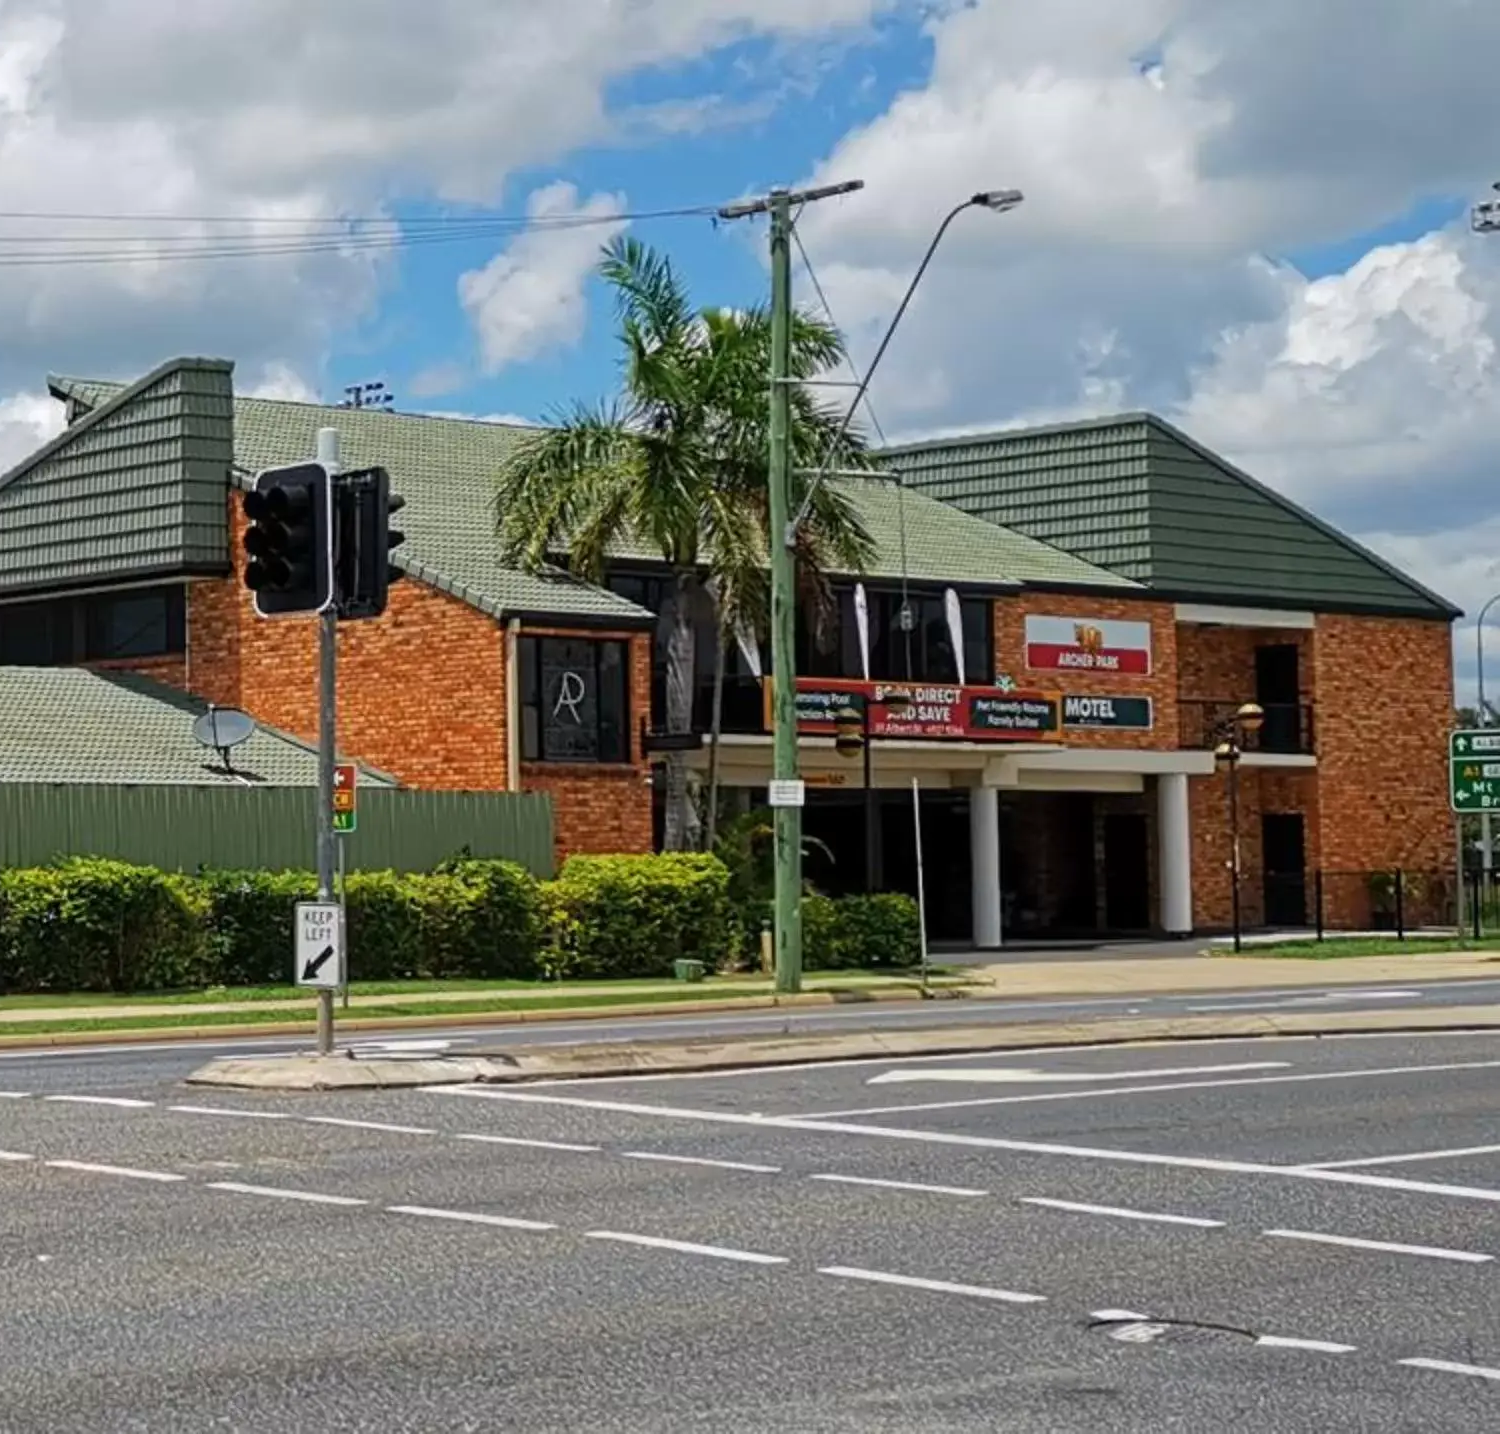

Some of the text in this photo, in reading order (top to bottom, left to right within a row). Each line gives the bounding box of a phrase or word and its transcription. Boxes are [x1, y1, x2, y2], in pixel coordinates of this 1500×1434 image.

[1058, 651, 1119, 669] ARCHER PARK
[915, 687, 963, 705] DIRECT
[918, 706, 952, 723] SAVE
[1065, 697, 1116, 719] MOTEL
[1472, 781, 1493, 794] Mt
[305, 911, 334, 925] KEEP
[305, 927, 332, 942] LEFT
